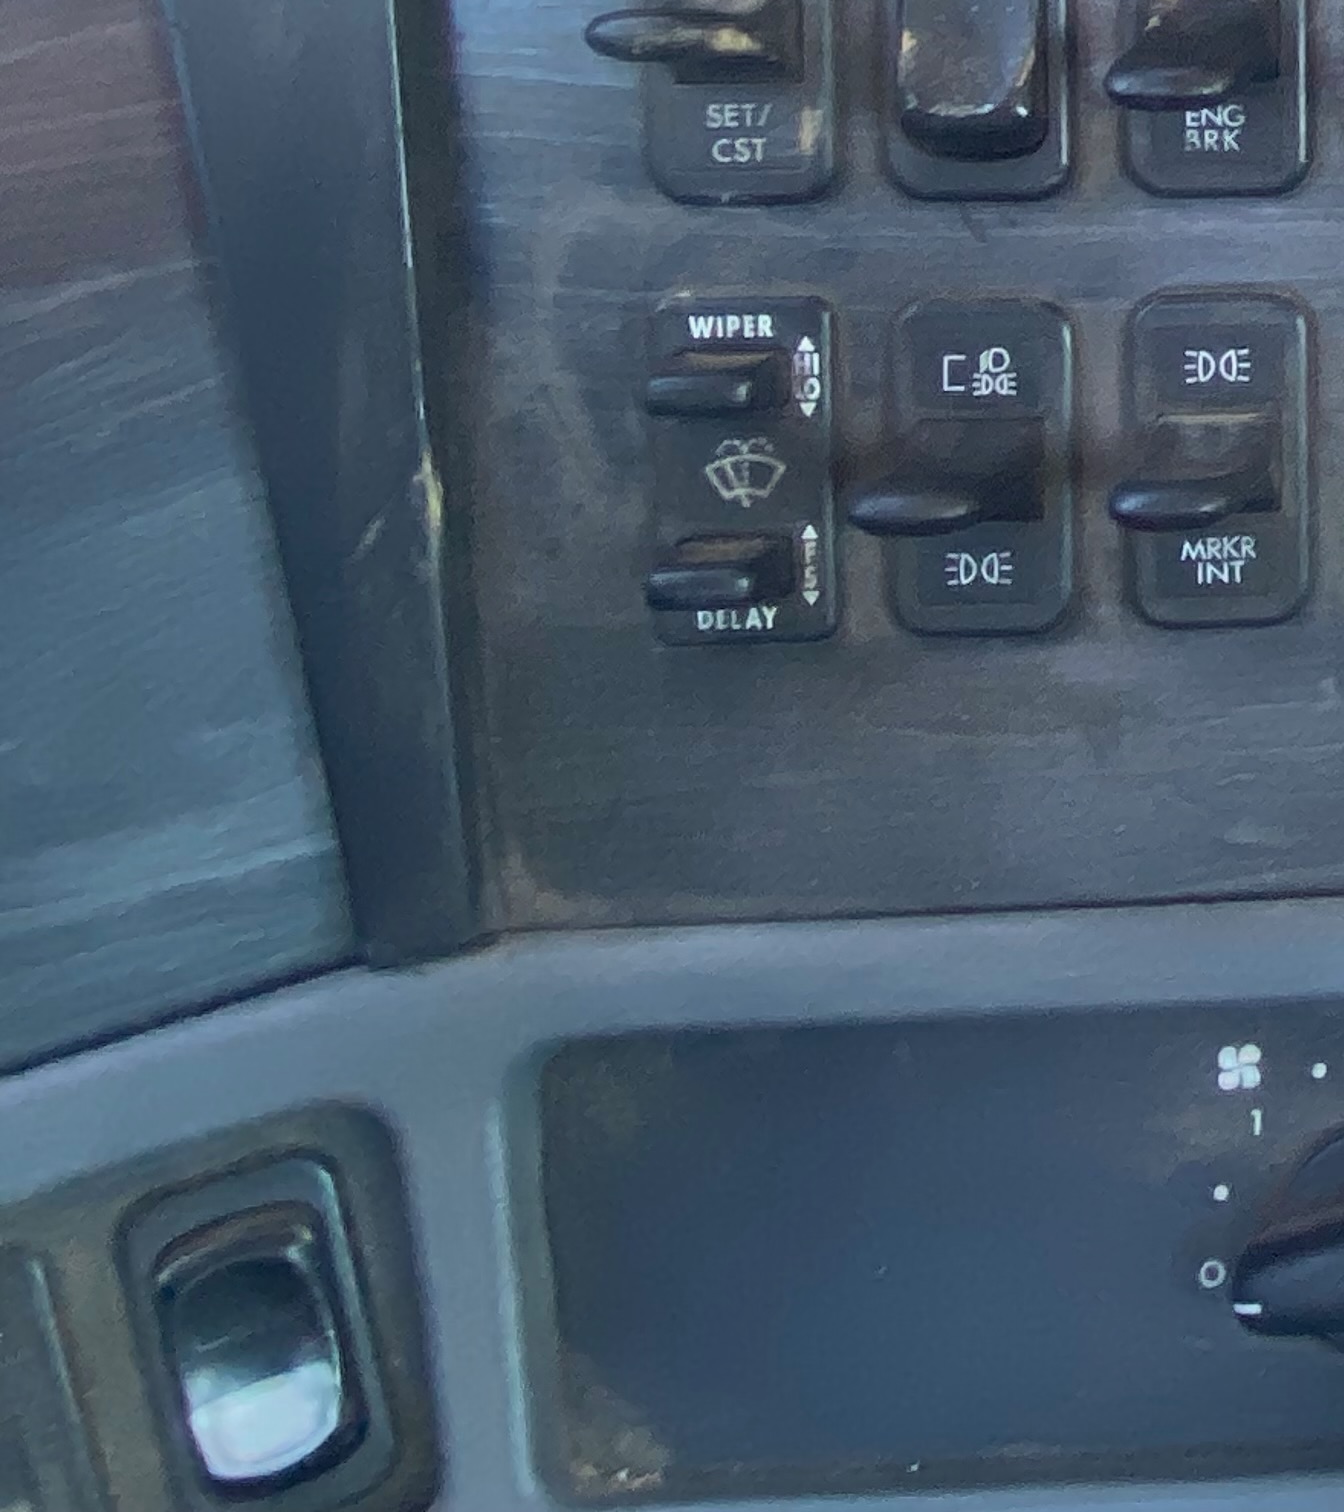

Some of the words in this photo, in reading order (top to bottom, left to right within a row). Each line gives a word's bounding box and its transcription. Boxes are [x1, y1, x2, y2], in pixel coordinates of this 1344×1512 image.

[705, 103, 773, 129] SET/
[1184, 104, 1247, 125] ENG
[711, 138, 767, 163] CST
[1184, 127, 1241, 152] BRK
[688, 314, 775, 339] WIPER
[1180, 534, 1257, 561] MRKR
[1196, 559, 1245, 586] INT
[696, 605, 779, 631] DELAY
[1251, 1108, 1262, 1136] 1
